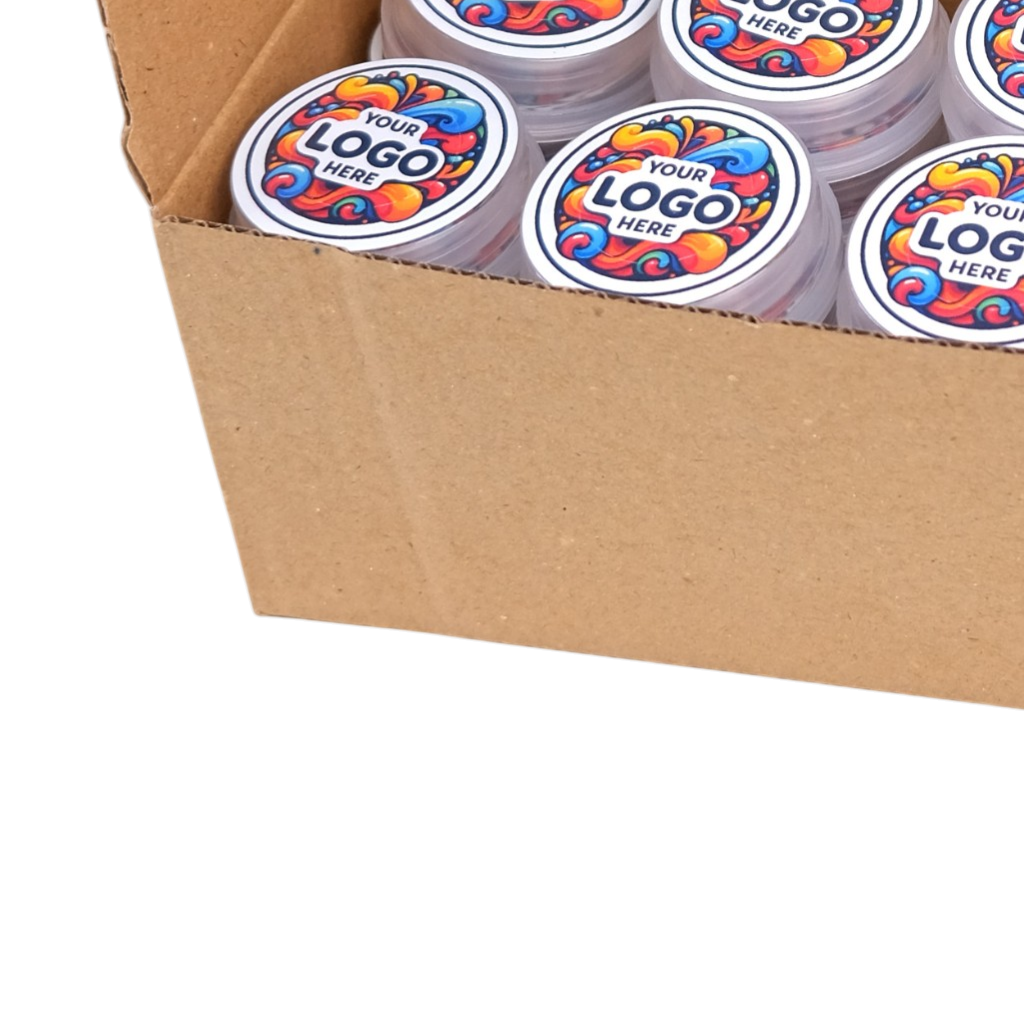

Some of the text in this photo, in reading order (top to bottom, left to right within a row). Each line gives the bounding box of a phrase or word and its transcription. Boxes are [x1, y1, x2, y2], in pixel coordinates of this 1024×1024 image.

[746, 13, 803, 40] HERE
[365, 111, 420, 137] YOUR
[304, 122, 439, 177] LOGO
[322, 160, 379, 186] HERE
[649, 160, 708, 182] YOUR
[591, 175, 734, 225] LOGO
[616, 216, 676, 238] HERE
[948, 260, 1011, 283] HERE
